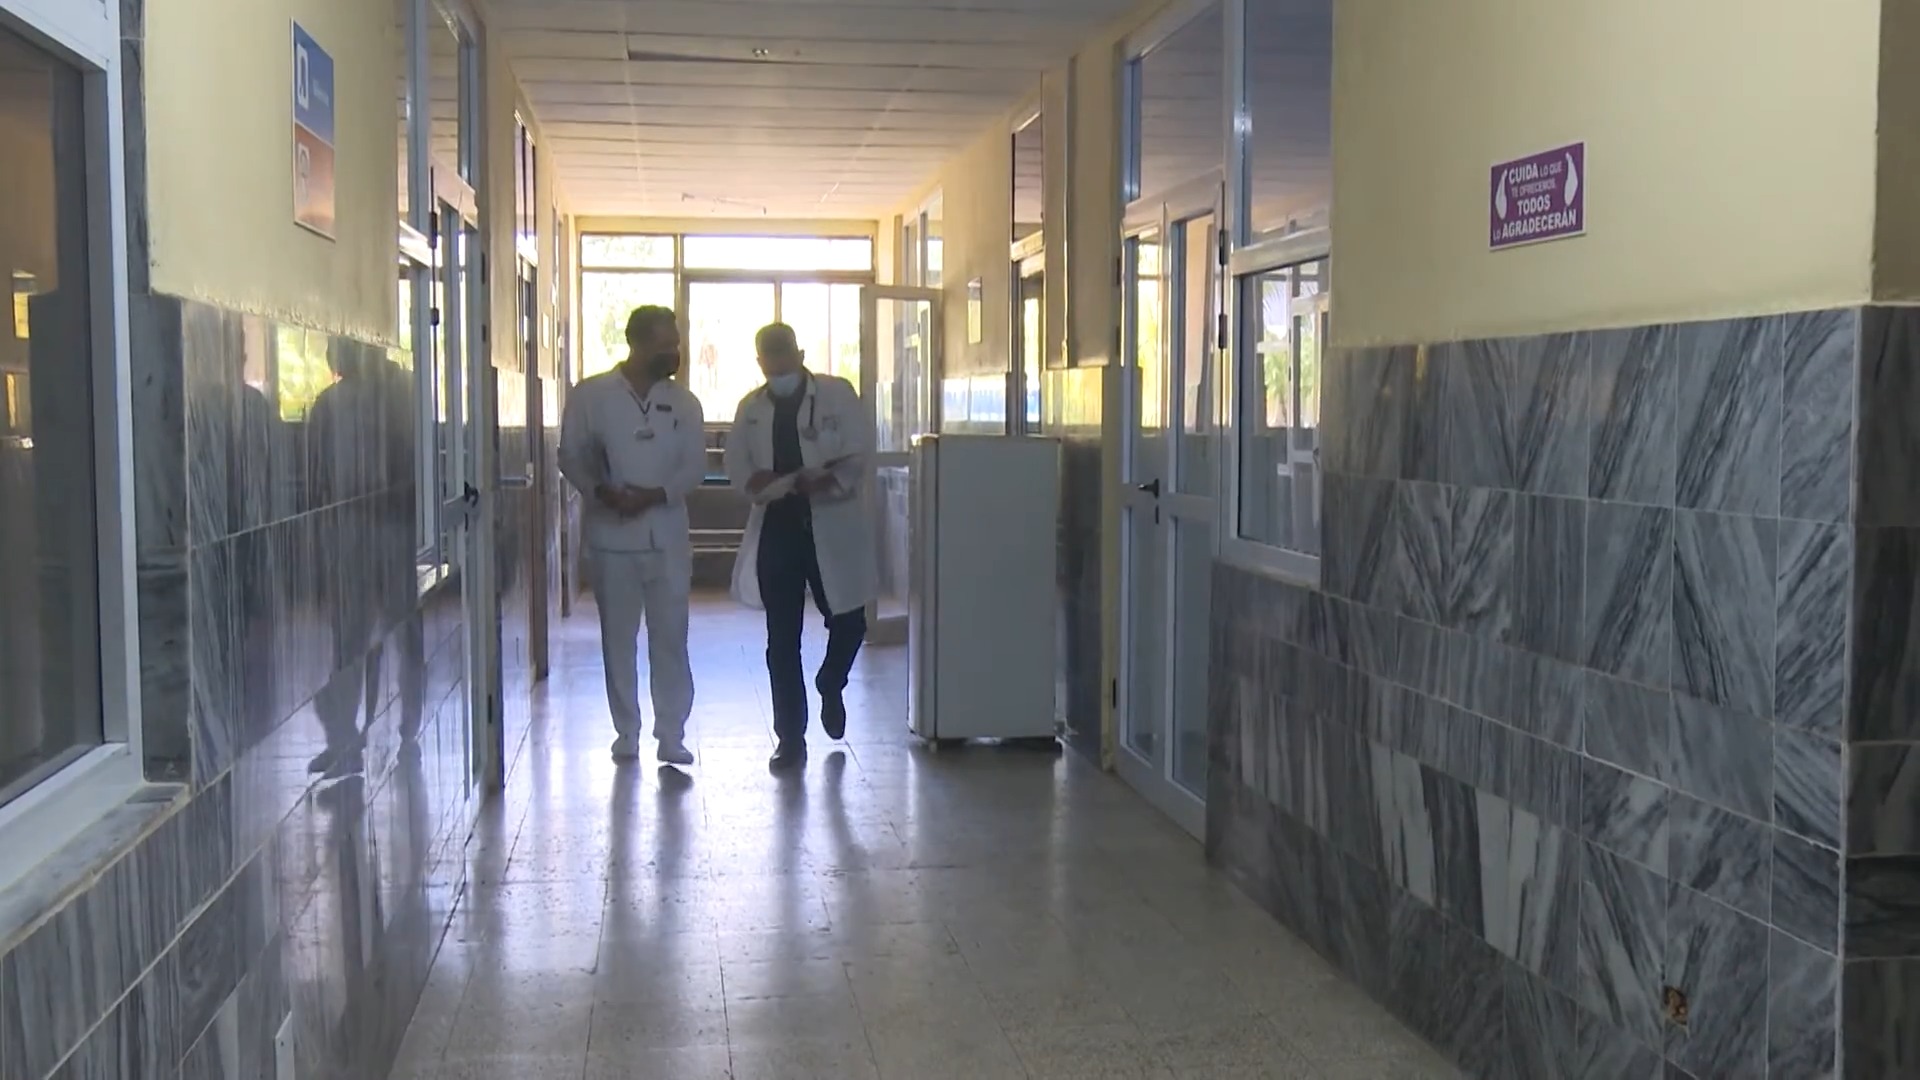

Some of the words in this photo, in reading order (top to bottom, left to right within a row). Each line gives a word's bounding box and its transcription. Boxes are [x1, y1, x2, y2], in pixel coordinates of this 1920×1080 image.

[1508, 163, 1538, 184] CUIDA
[1540, 165, 1548, 177] LO
[1549, 161, 1562, 175] QUE
[1511, 187, 1518, 197] TE
[1517, 194, 1551, 215] TODOS
[1493, 229, 1501, 241] LO
[1502, 207, 1576, 239] AGRADECERÁN
